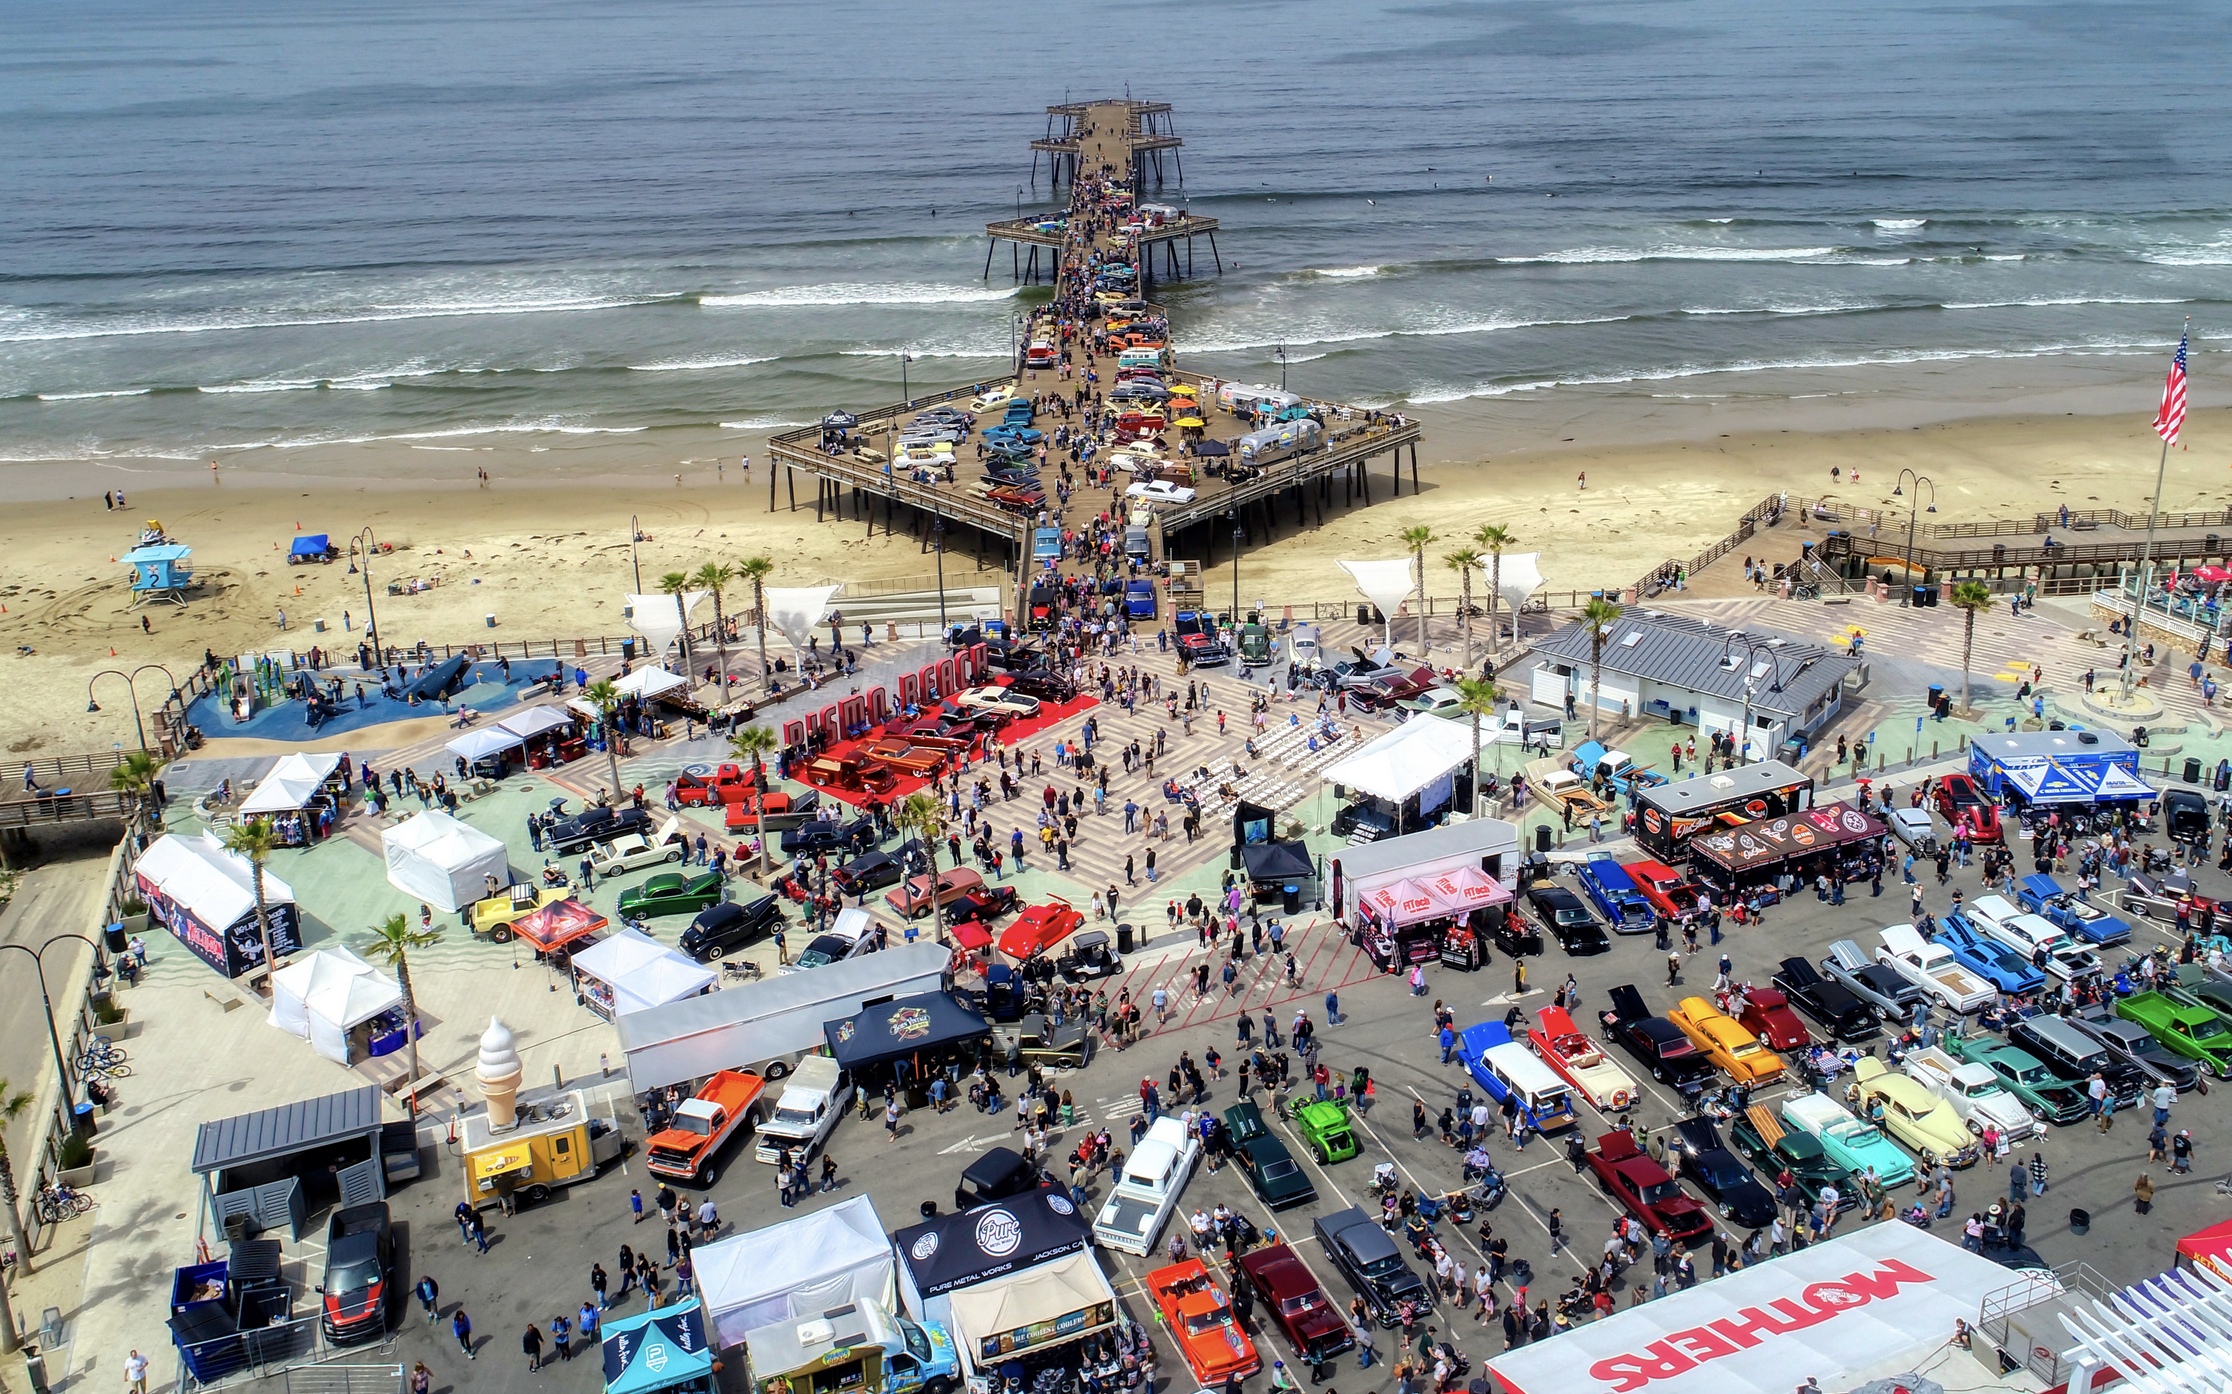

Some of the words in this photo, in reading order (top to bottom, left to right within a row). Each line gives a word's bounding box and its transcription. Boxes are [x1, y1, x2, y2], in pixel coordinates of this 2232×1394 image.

[149, 574, 160, 588] 2
[783, 685, 888, 750] PISMO
[898, 642, 989, 712] BEACH
[978, 1220, 1021, 1246] Pure
[1032, 1245, 1072, 1261] JACKSON,
[1072, 1241, 1084, 1250] CA
[929, 1281, 952, 1293] PURE
[953, 1273, 981, 1287] METAL
[981, 1262, 1013, 1277] WORKS
[1012, 1332, 1027, 1344] THE
[1026, 1324, 1056, 1340] COOLEST
[1589, 1258, 1937, 1393] MOTHERS
[679, 1329, 692, 1351] hello
